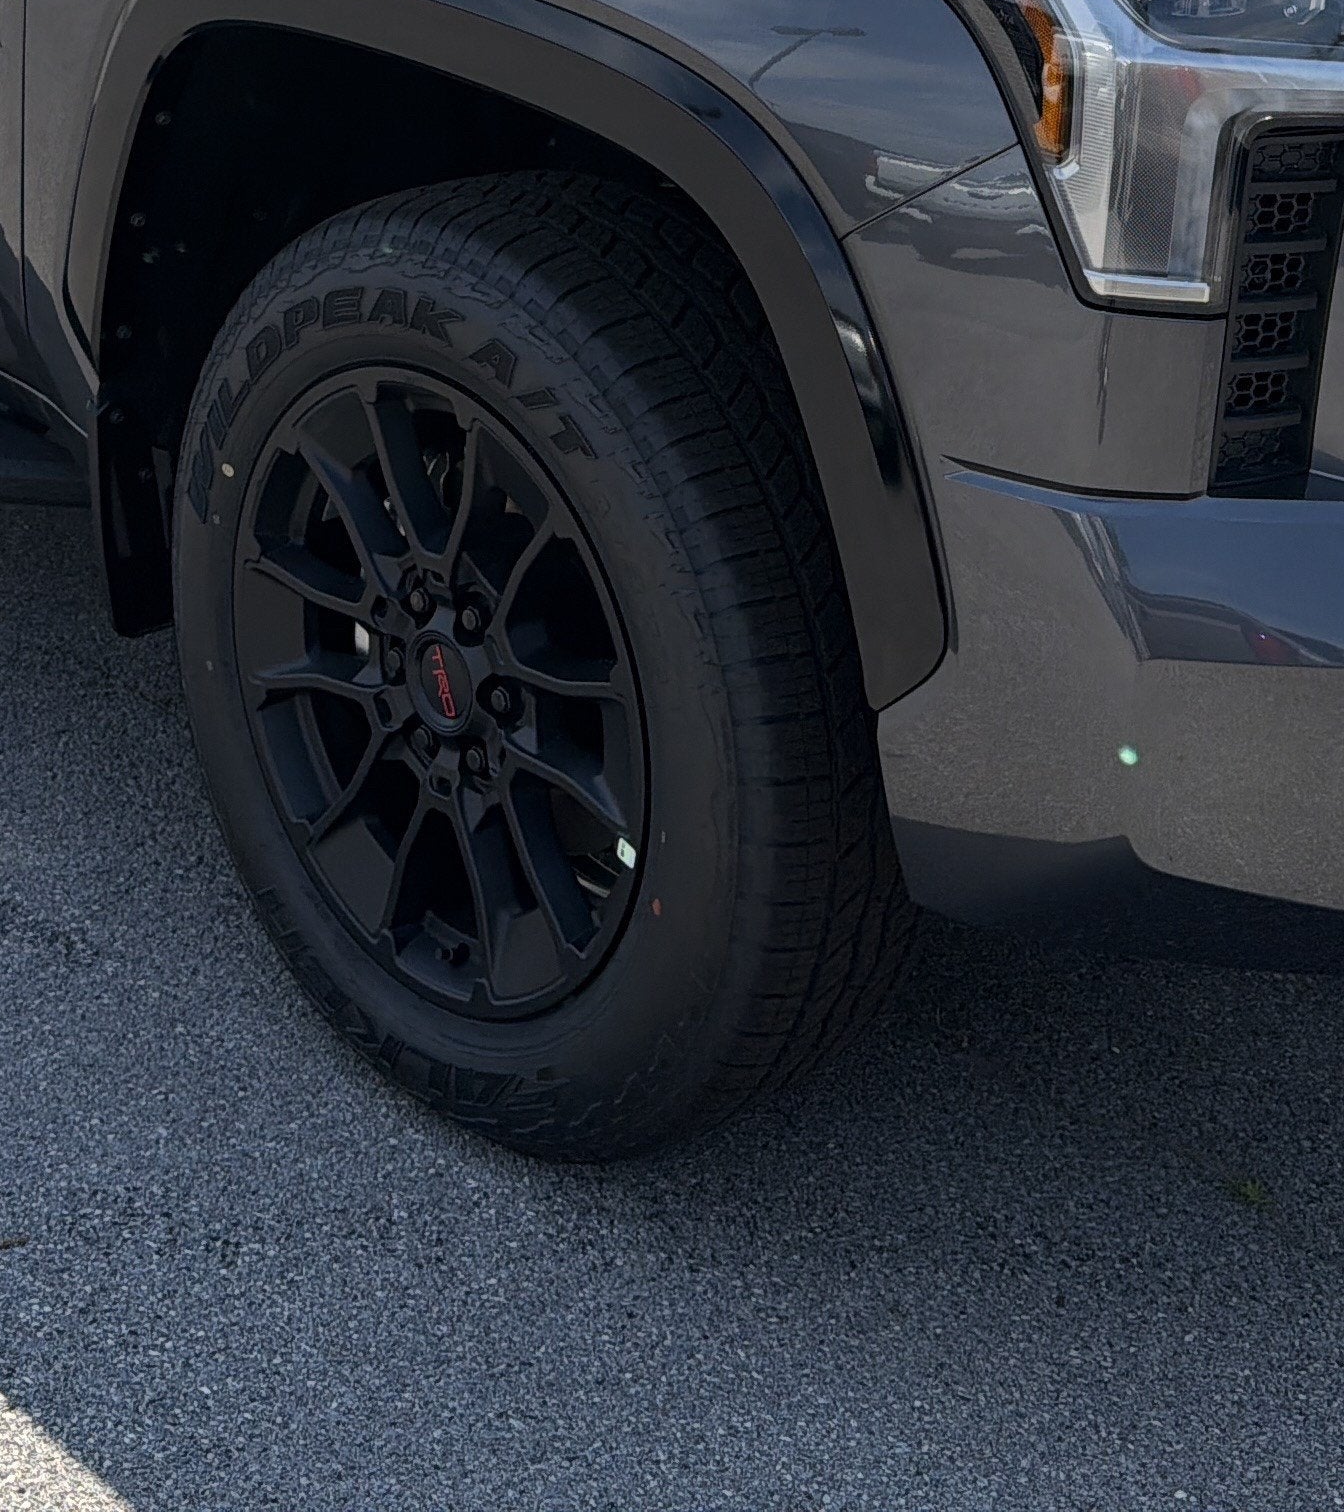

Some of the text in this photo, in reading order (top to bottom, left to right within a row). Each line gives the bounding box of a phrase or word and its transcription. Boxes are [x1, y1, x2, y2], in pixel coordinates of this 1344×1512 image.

[188, 286, 597, 524] WILDPEAK A/T
[431, 644, 456, 717] TRD
